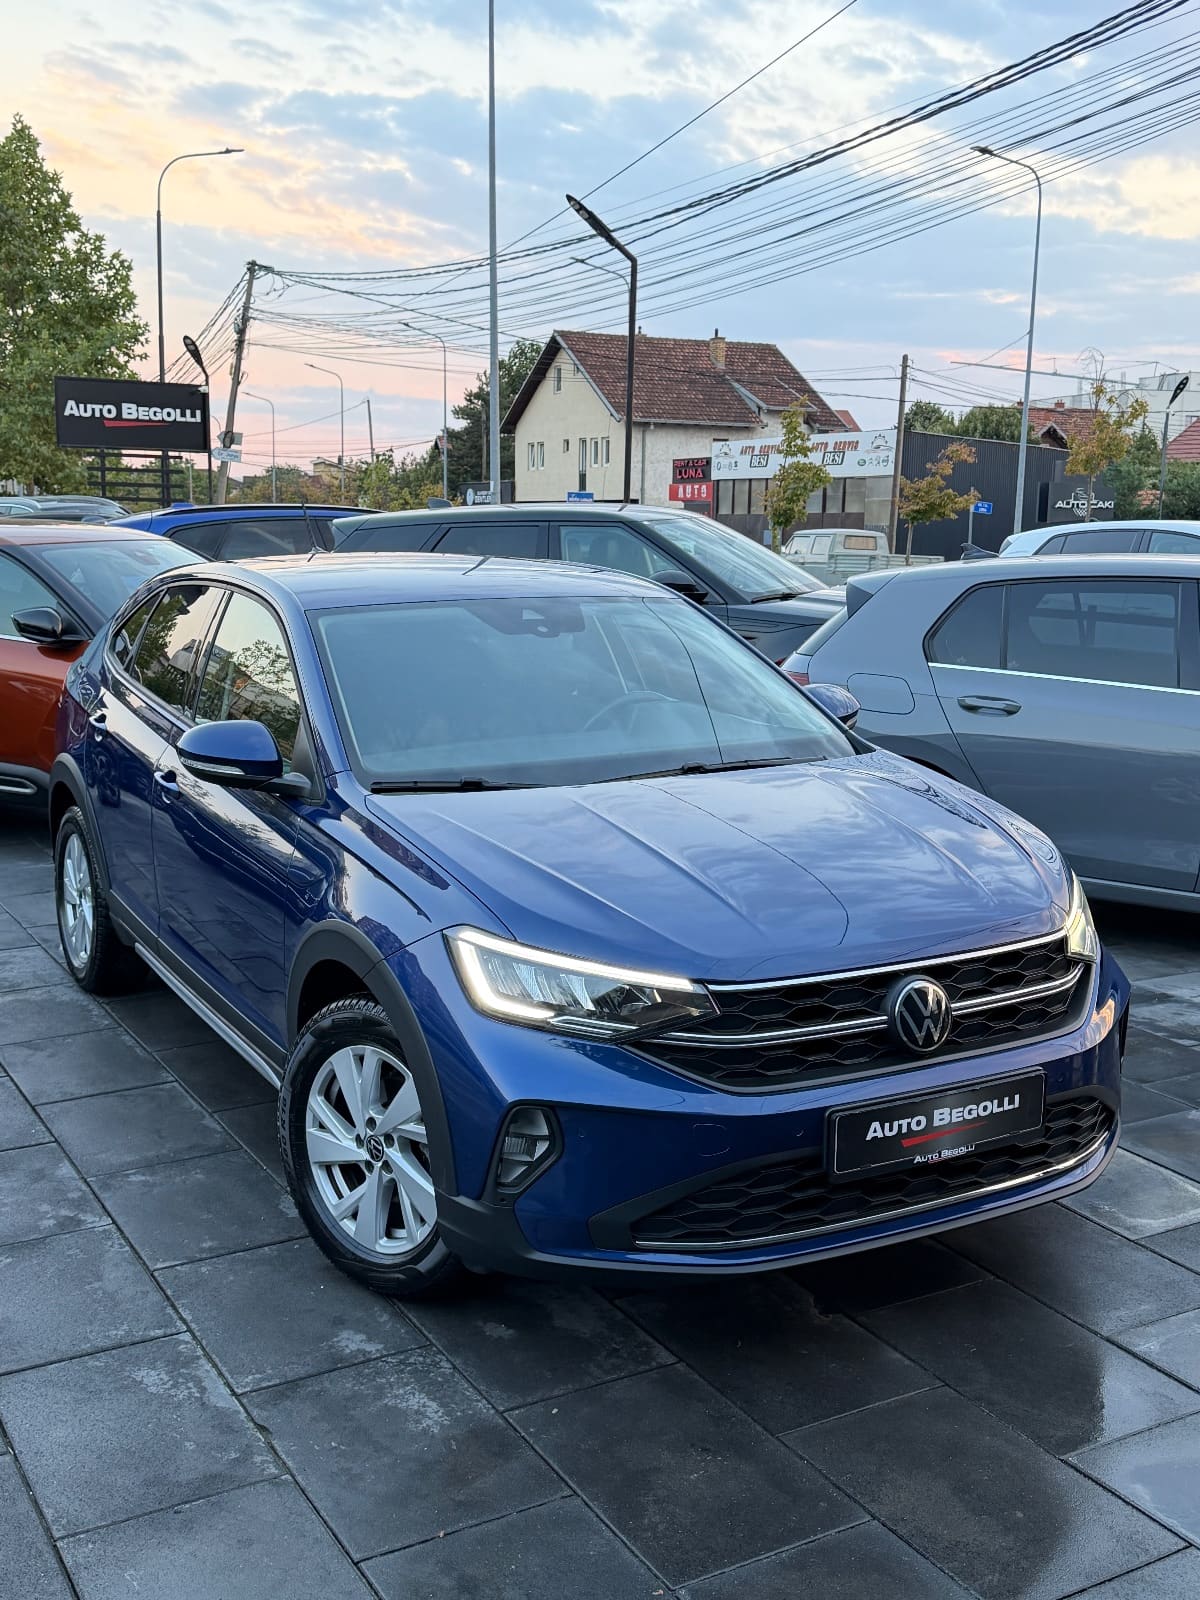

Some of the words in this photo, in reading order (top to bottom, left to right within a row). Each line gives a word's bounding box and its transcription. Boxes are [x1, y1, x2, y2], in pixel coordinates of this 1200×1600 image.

[63, 399, 117, 419] AUTO
[121, 402, 202, 423] BEGOLLI
[676, 467, 704, 479] LUNA
[677, 484, 707, 498] AUTO
[865, 1114, 927, 1141] AUTO
[933, 1094, 1020, 1127] BEGOLLI
[913, 1153, 939, 1164] AUTO
[941, 1144, 976, 1157] BEGOLLI
